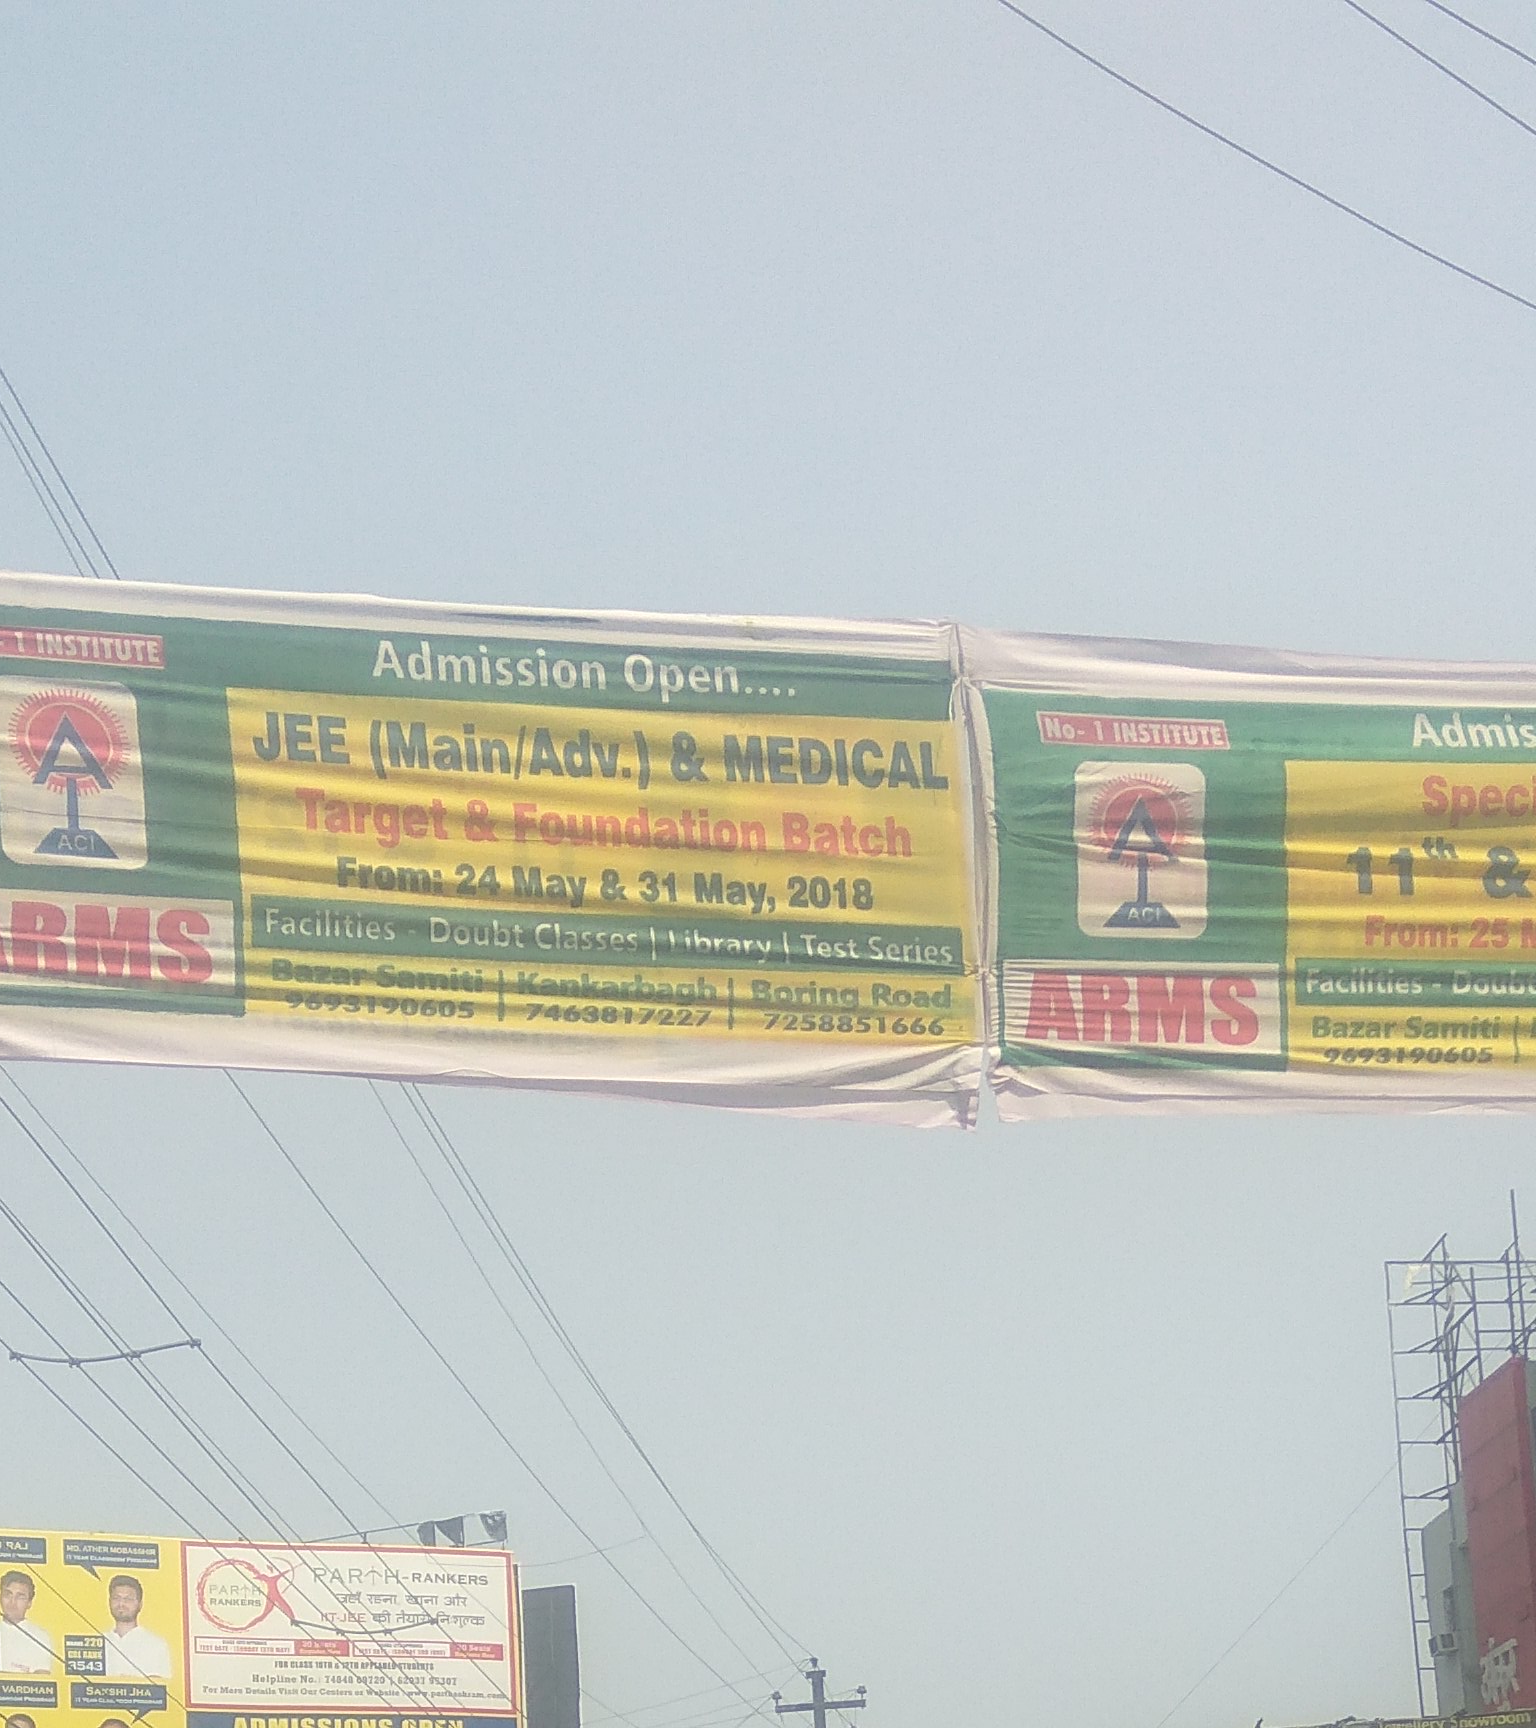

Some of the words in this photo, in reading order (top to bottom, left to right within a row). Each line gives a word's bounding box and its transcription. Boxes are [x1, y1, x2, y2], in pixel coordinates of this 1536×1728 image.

[37, 633, 160, 663] INSTITUTE
[253, 711, 350, 766] JEE
[671, 730, 708, 783] &
[723, 734, 948, 790] MEDICAL
[296, 788, 448, 848] Target
[464, 801, 498, 843] &
[514, 803, 766, 853] Foundation
[782, 811, 912, 858] Batch
[337, 857, 444, 894] From:
[455, 864, 500, 896] 24
[513, 865, 586, 907] May
[600, 868, 626, 900] &
[638, 872, 677, 902] 31
[694, 873, 775, 911] May,
[788, 875, 873, 910] 2018
[527, 1003, 712, 1026] 7463817227
[765, 1011, 944, 1036] 7258851666
[1024, 971, 1259, 1046] ARMS
[1311, 1016, 1394, 1040] Bazar
[1405, 1015, 1499, 1040] Samiti
